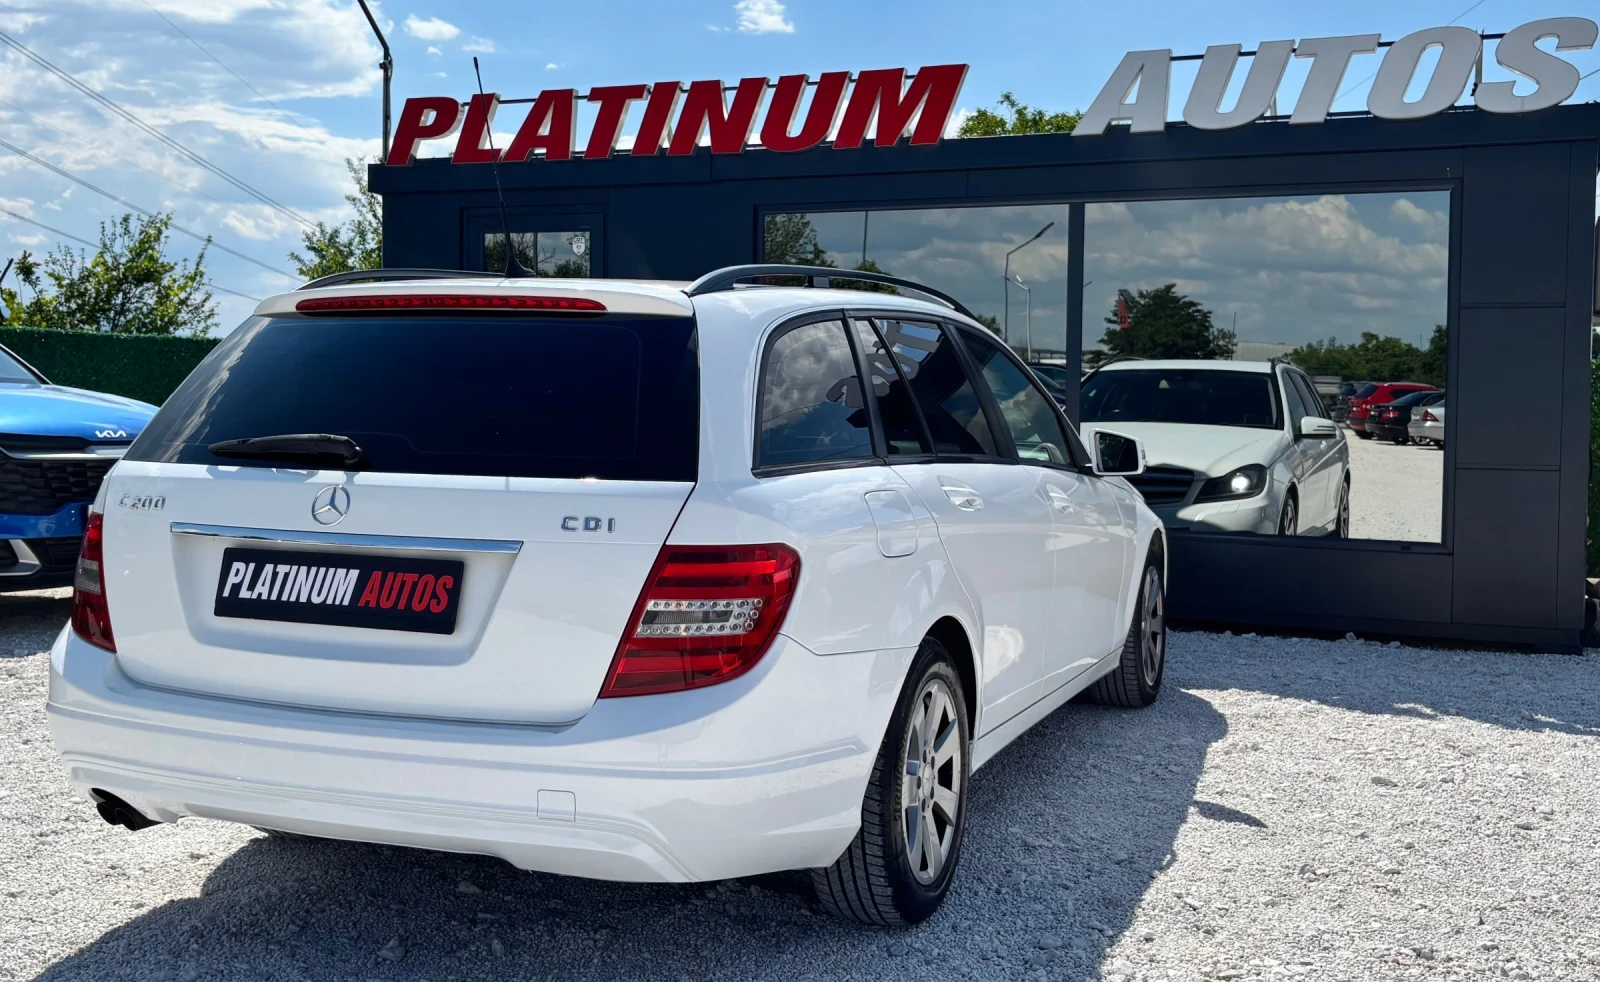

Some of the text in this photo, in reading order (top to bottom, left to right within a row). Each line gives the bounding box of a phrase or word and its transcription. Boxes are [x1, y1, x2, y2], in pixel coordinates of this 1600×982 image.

[385, 16, 1599, 166] PLATINUM AUTOS
[561, 516, 616, 533] CDI
[222, 561, 454, 613] PLATINUM AUTOS
